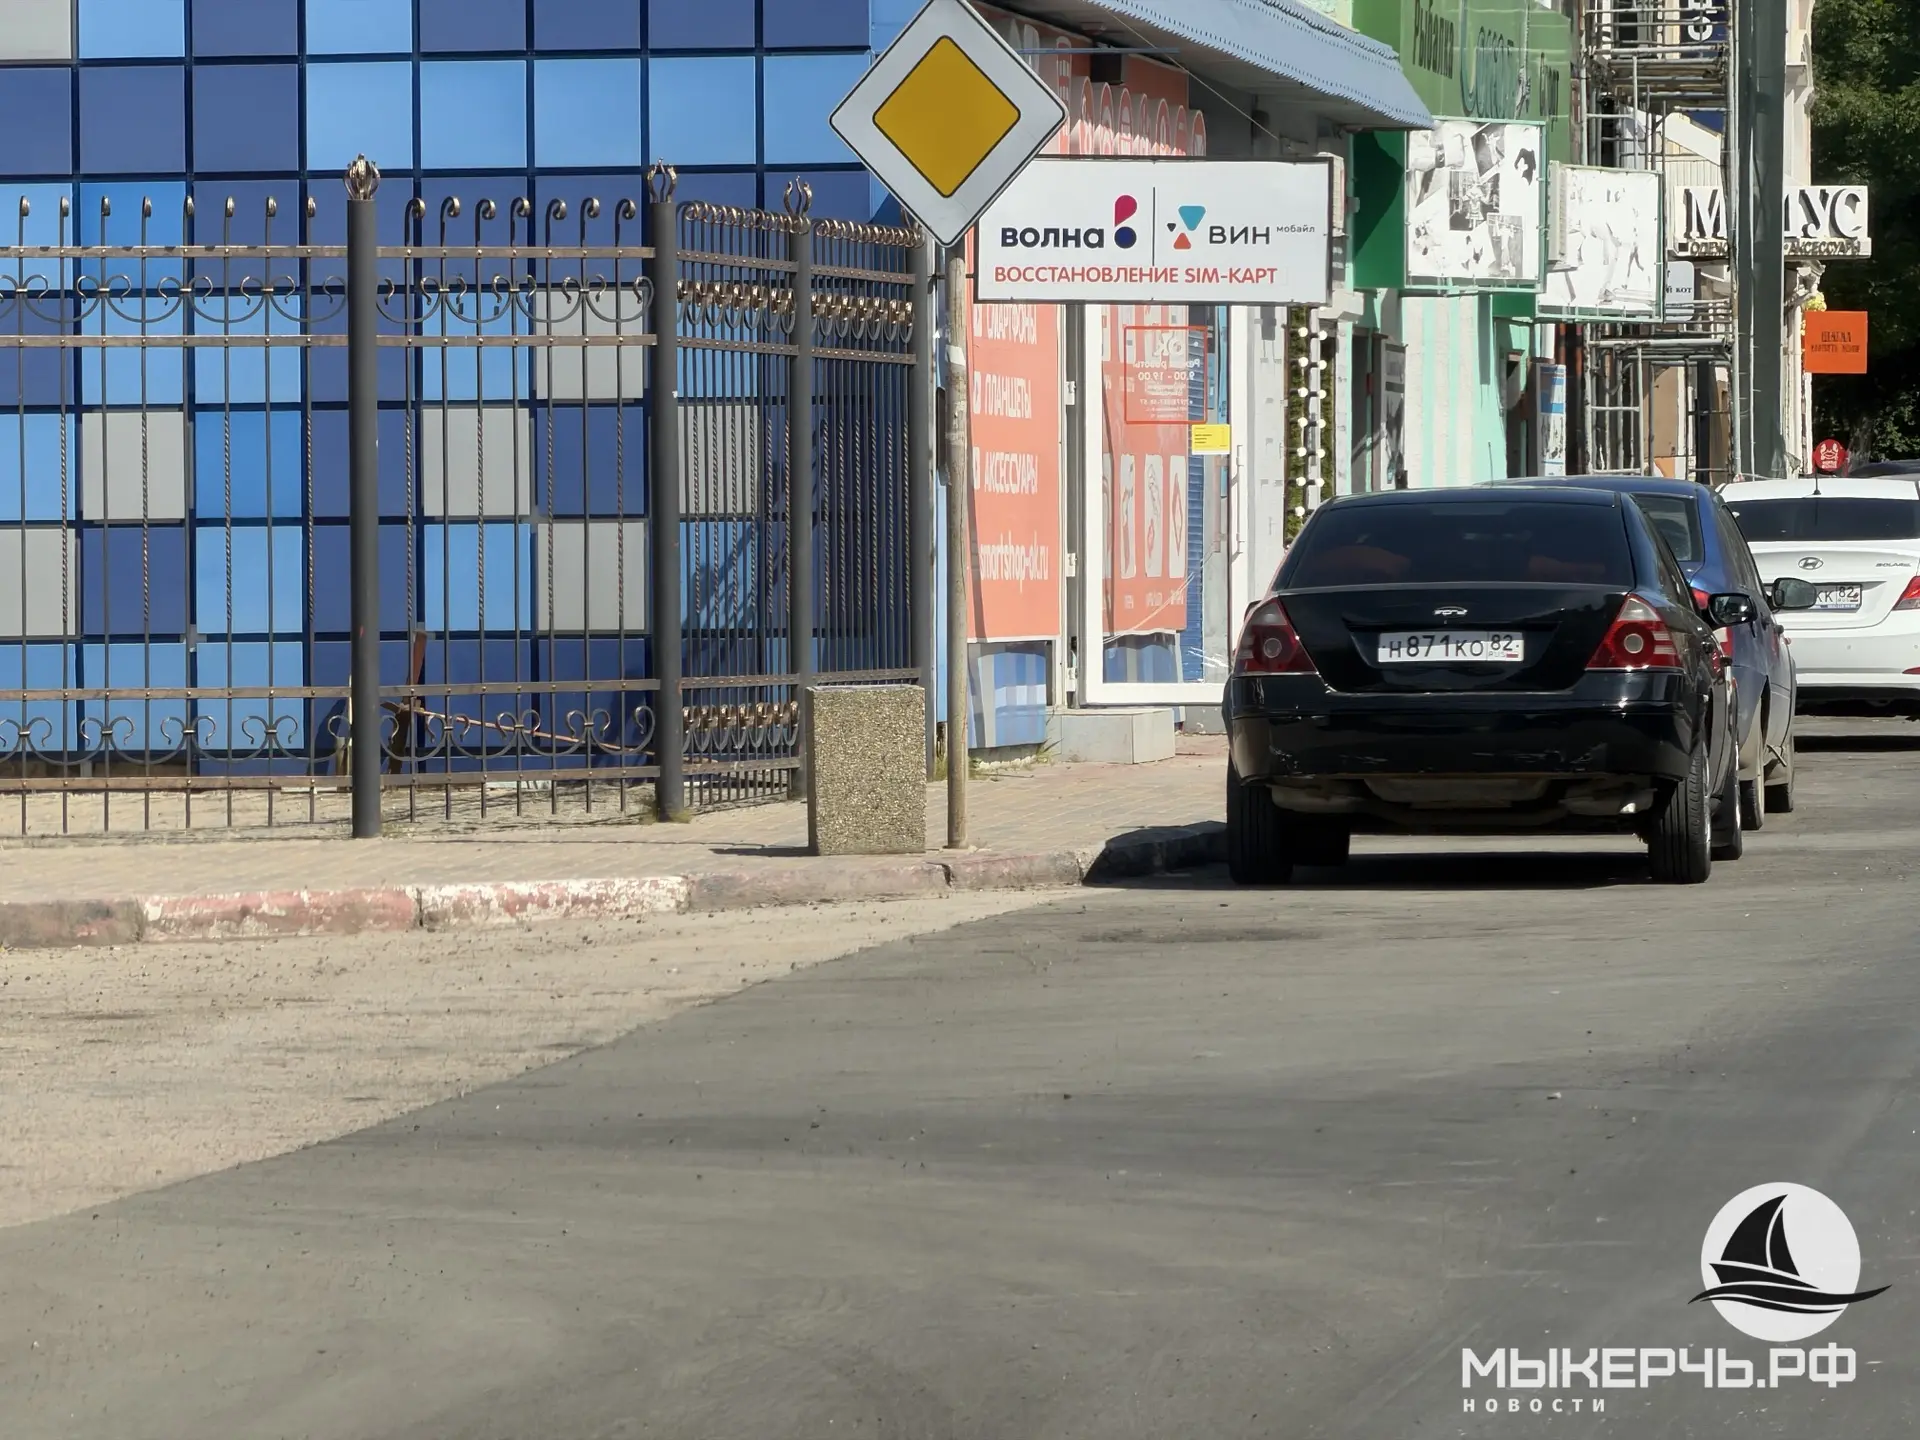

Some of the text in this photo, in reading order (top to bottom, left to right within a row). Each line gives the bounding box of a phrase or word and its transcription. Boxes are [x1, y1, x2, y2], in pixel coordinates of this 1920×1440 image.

[1276, 224, 1316, 234] мобайл
[994, 266, 1278, 285] ВОССТАНОВЛЕНИЕ SIM-КАРТ
[984, 373, 1032, 419] ПЛАНШЕТЫ
[984, 451, 1038, 495] АКСЕССУАРЫ
[1838, 586, 1855, 598] 82
[1389, 634, 1513, 658] Н871КО 82
